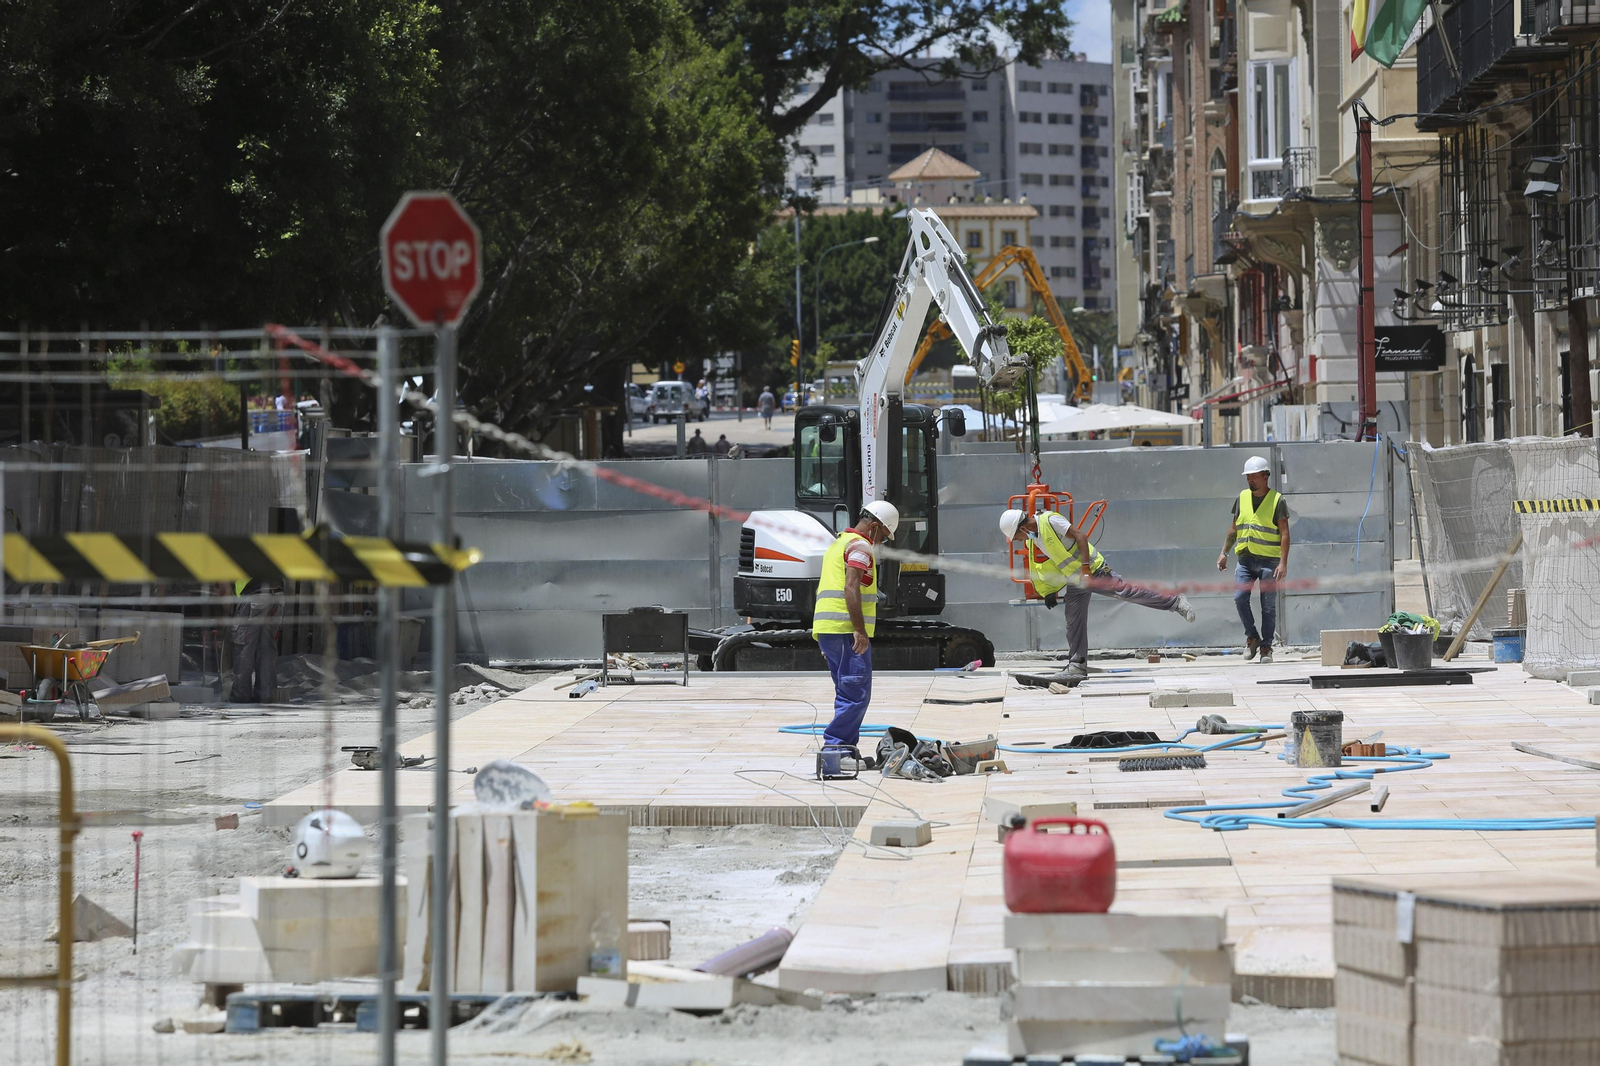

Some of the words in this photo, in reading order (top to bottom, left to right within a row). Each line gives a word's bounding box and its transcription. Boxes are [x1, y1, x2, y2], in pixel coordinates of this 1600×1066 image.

[393, 240, 472, 281] STOP
[884, 321, 898, 349] Bobcat
[109, 436, 116, 447] 7
[760, 564, 773, 573] Bobcat
[775, 588, 793, 602] E50
